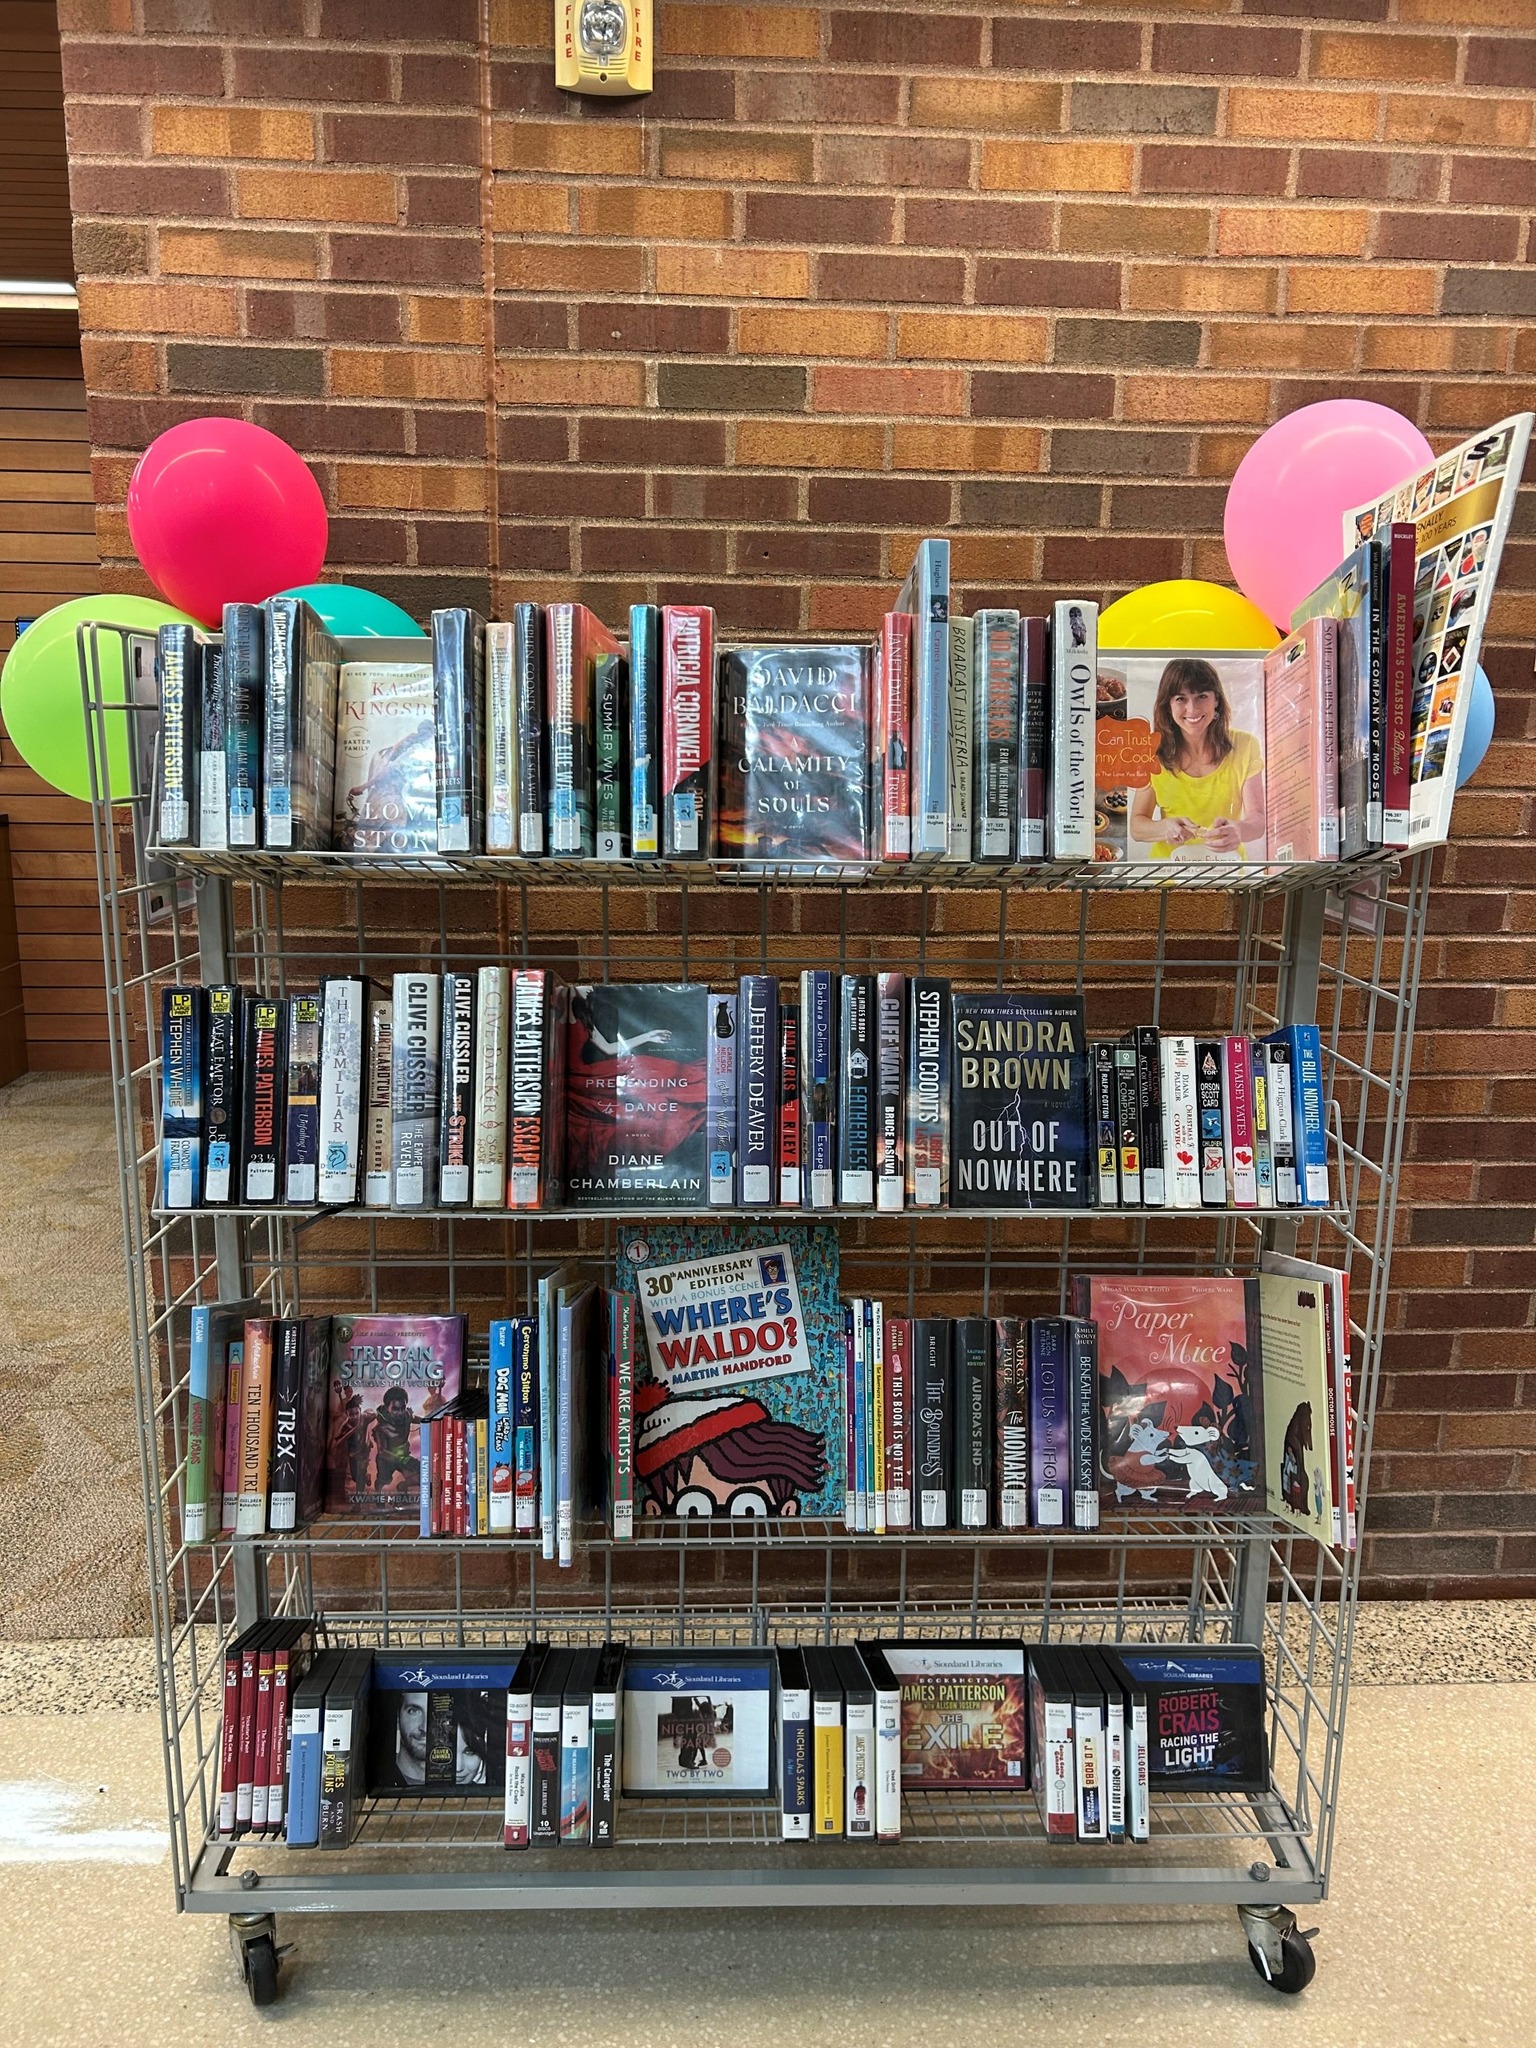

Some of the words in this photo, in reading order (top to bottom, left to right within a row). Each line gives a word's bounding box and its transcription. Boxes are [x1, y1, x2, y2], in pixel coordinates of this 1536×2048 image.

[565, 4, 573, 59] FIRE
[634, 7, 642, 62] FIRE
[933, 560, 942, 588] Hughes
[1371, 608, 1380, 622] IN
[1395, 592, 1406, 667] AMERICA'S
[676, 616, 701, 684] PATRICIA
[933, 630, 943, 662] Cranes
[1371, 626, 1380, 655] THE
[164, 650, 184, 699] JAMES
[753, 666, 836, 687] DAVID
[733, 694, 856, 715] BALDACCI
[1070, 664, 1092, 725] Owls
[1371, 661, 1380, 725] COMPANY
[1393, 669, 1405, 726] CLASSIC
[164, 702, 185, 789] PATTERSON
[675, 687, 701, 775] CORNWELL
[1070, 728, 1085, 747] of
[1098, 729, 1123, 745] Can
[1126, 729, 1152, 746] Trust
[1371, 729, 1380, 747] OF
[737, 756, 850, 774] CALAMITY
[999, 748, 1008, 765] ERIK
[1070, 750, 1085, 777] the
[1120, 748, 1155, 763] Cook
[1392, 728, 1405, 777] Ballparks
[1371, 752, 1380, 799] MOOSE
[757, 796, 830, 814] SOULS
[999, 767, 1009, 818] WEIHENMAYER
[1070, 779, 1085, 823] Worl
[604, 839, 614, 852] 9
[173, 995, 190, 1006] LP
[213, 992, 229, 1003] LP
[259, 1007, 275, 1018] LP
[299, 1001, 315, 1012] LP
[338, 986, 348, 1024] THE
[407, 982, 428, 1031] CLIVE
[455, 978, 471, 1017] CLIVE
[515, 975, 544, 1028] JAMES
[816, 982, 828, 1021] Barbara
[880, 998, 900, 1043] CLIFF
[918, 990, 940, 1058] STEPHEN
[454, 1020, 471, 1084] CUSSLER
[750, 1005, 767, 1078] JEFFERY
[814, 1023, 828, 1065] Delinsky
[957, 1020, 1076, 1053] SANDRA
[370, 1023, 392, 1109] PORTLANDTOWN
[406, 1038, 427, 1113] CUSSLER
[513, 1030, 543, 1113] PATTERSON
[880, 1044, 900, 1097] WALK
[961, 1057, 1072, 1090] BROWN
[1234, 1062, 1246, 1097] MAISEY
[1276, 1065, 1286, 1084] Mary
[332, 1032, 348, 1133] FAMILIAR
[585, 1078, 688, 1088] PRETENDING
[918, 1062, 940, 1124] COONTS
[1174, 1071, 1182, 1102] PALMER
[1182, 1074, 1190, 1099] DIANA
[1200, 1083, 1221, 1091] ORSON
[1201, 1091, 1220, 1099] SCOTT
[1101, 1095, 1109, 1120] COTTON
[1120, 1081, 1129, 1127] COMPTON
[1127, 1089, 1136, 1120] RALPH
[1202, 1099, 1219, 1107] CARD
[1276, 1086, 1286, 1115] Higgins
[748, 1082, 766, 1154] DEAVER
[1236, 1099, 1247, 1137] YATES
[1278, 1118, 1286, 1140] Clark
[972, 1120, 1020, 1152] OUT
[1032, 1120, 1060, 1153] OF
[608, 1154, 664, 1165] DIANE
[569, 1178, 701, 1189] CHAMBERLAIN
[958, 1158, 1078, 1193] NOWHERE
[689, 1271, 745, 1290] EDITION
[652, 1288, 793, 1338] WHERE'S
[1106, 1301, 1195, 1337] Paper
[195, 1316, 204, 1343] MCCANN
[657, 1316, 798, 1371] WALDO?
[351, 1345, 434, 1362] TRISTAN
[520, 1325, 532, 1370] Geronimo
[1150, 1333, 1226, 1364] Mice
[340, 1360, 444, 1380] STRONG
[618, 1361, 631, 1383] WE
[671, 1366, 719, 1385] MARTIN
[723, 1353, 792, 1375] HANDFORD
[1003, 1347, 1013, 1385] PAIGE
[1015, 1338, 1025, 1394] MORGAN
[248, 1384, 262, 1405] TEN
[342, 1379, 387, 1387] DESTROYS
[388, 1379, 404, 1387] THE
[406, 1379, 441, 1387] WORLD
[520, 1371, 532, 1404] Stilton
[893, 1376, 903, 1398] THIS
[926, 1378, 945, 1404] THE
[618, 1388, 631, 1413] ARE
[893, 1400, 903, 1428] BOOK
[972, 1376, 983, 1437] AURORA'S
[277, 1407, 296, 1459] TREX
[1345, 1377, 1353, 1460] OLIVIA
[246, 1407, 262, 1469] THOUSAND
[617, 1417, 631, 1475] ARTISTS
[893, 1430, 903, 1440] IS
[920, 1407, 945, 1478] BOUNDLESS
[893, 1443, 903, 1462] NOT
[972, 1440, 983, 1466] END
[893, 1465, 903, 1482] YET
[348, 1495, 385, 1504] KWAME
[934, 1660, 969, 1668] Siouxland
[970, 1660, 1003, 1668] Libraries
[900, 1685, 935, 1701] JAMES
[938, 1685, 1005, 1701] PATTERSON
[957, 1701, 981, 1709] JOSEPH
[1158, 1693, 1219, 1712] ROBERT
[661, 1724, 730, 1735] NICHOLAS
[940, 1714, 963, 1723] THE
[1158, 1708, 1220, 1736] CRAIS
[901, 1723, 1005, 1750] EXILE
[1160, 1735, 1197, 1748] RACING
[1199, 1732, 1219, 1744] THE
[603, 1753, 613, 1767] The
[1165, 1746, 1216, 1766] LIGHT
[325, 1753, 336, 1793] ROLLINS
[335, 1757, 344, 1788] JAMES
[602, 1767, 613, 1802] Caregiver
[666, 1770, 688, 1778] TWO
[690, 1770, 701, 1778] BY
[702, 1770, 724, 1778] TWO
[797, 1776, 806, 1806] SPARKS
